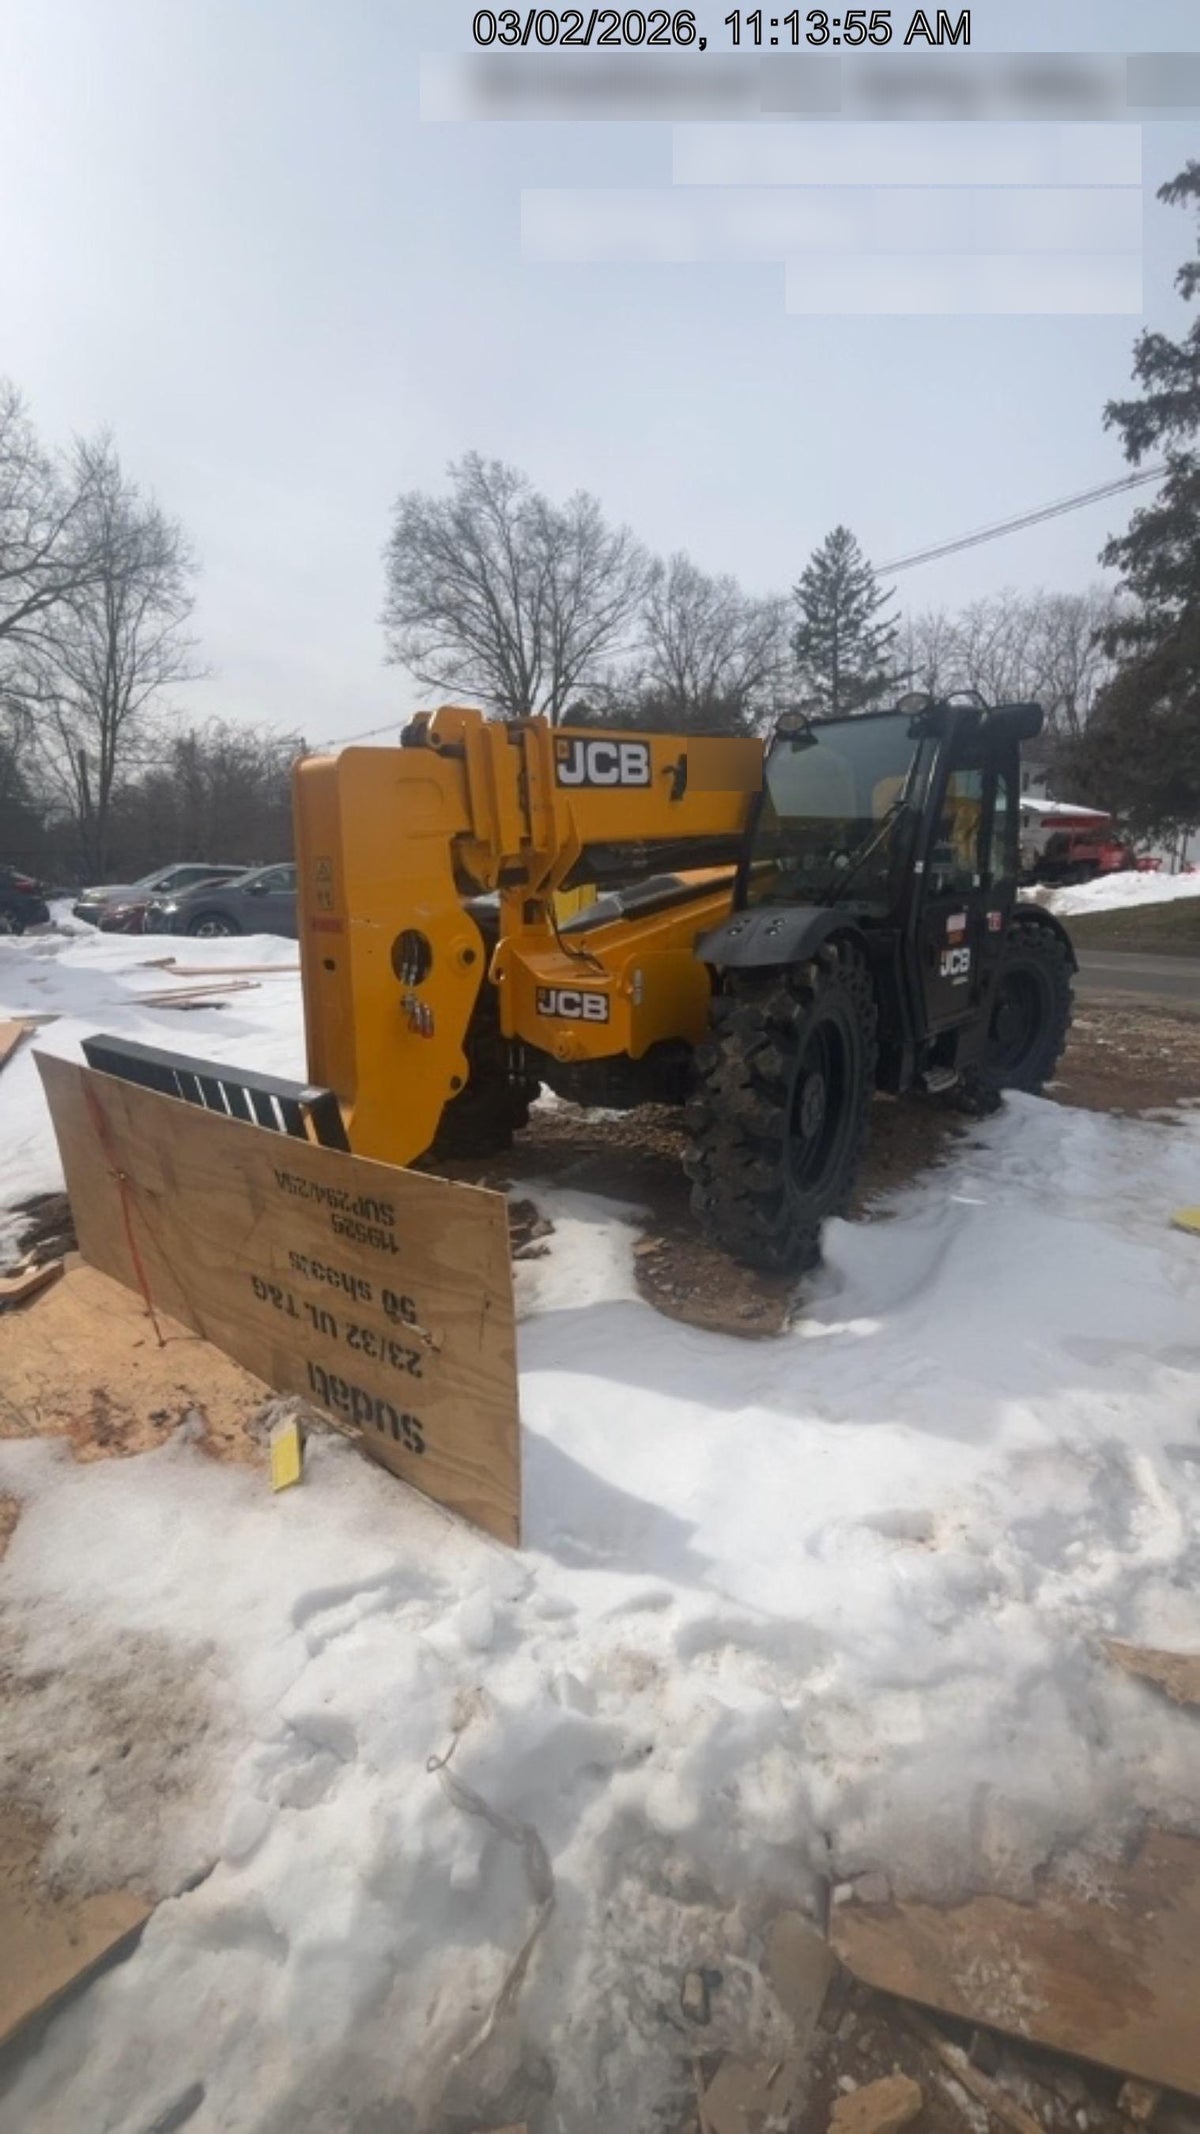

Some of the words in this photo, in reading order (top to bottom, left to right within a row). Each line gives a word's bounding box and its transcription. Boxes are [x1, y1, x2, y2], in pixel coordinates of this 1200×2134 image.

[557, 741, 649, 784] JCB
[940, 947, 971, 977] JCB
[538, 989, 608, 1021] JCB
[251, 1274, 300, 1319] T&G
[381, 1289, 418, 1324] 50
[346, 1322, 423, 1379] 23/32
